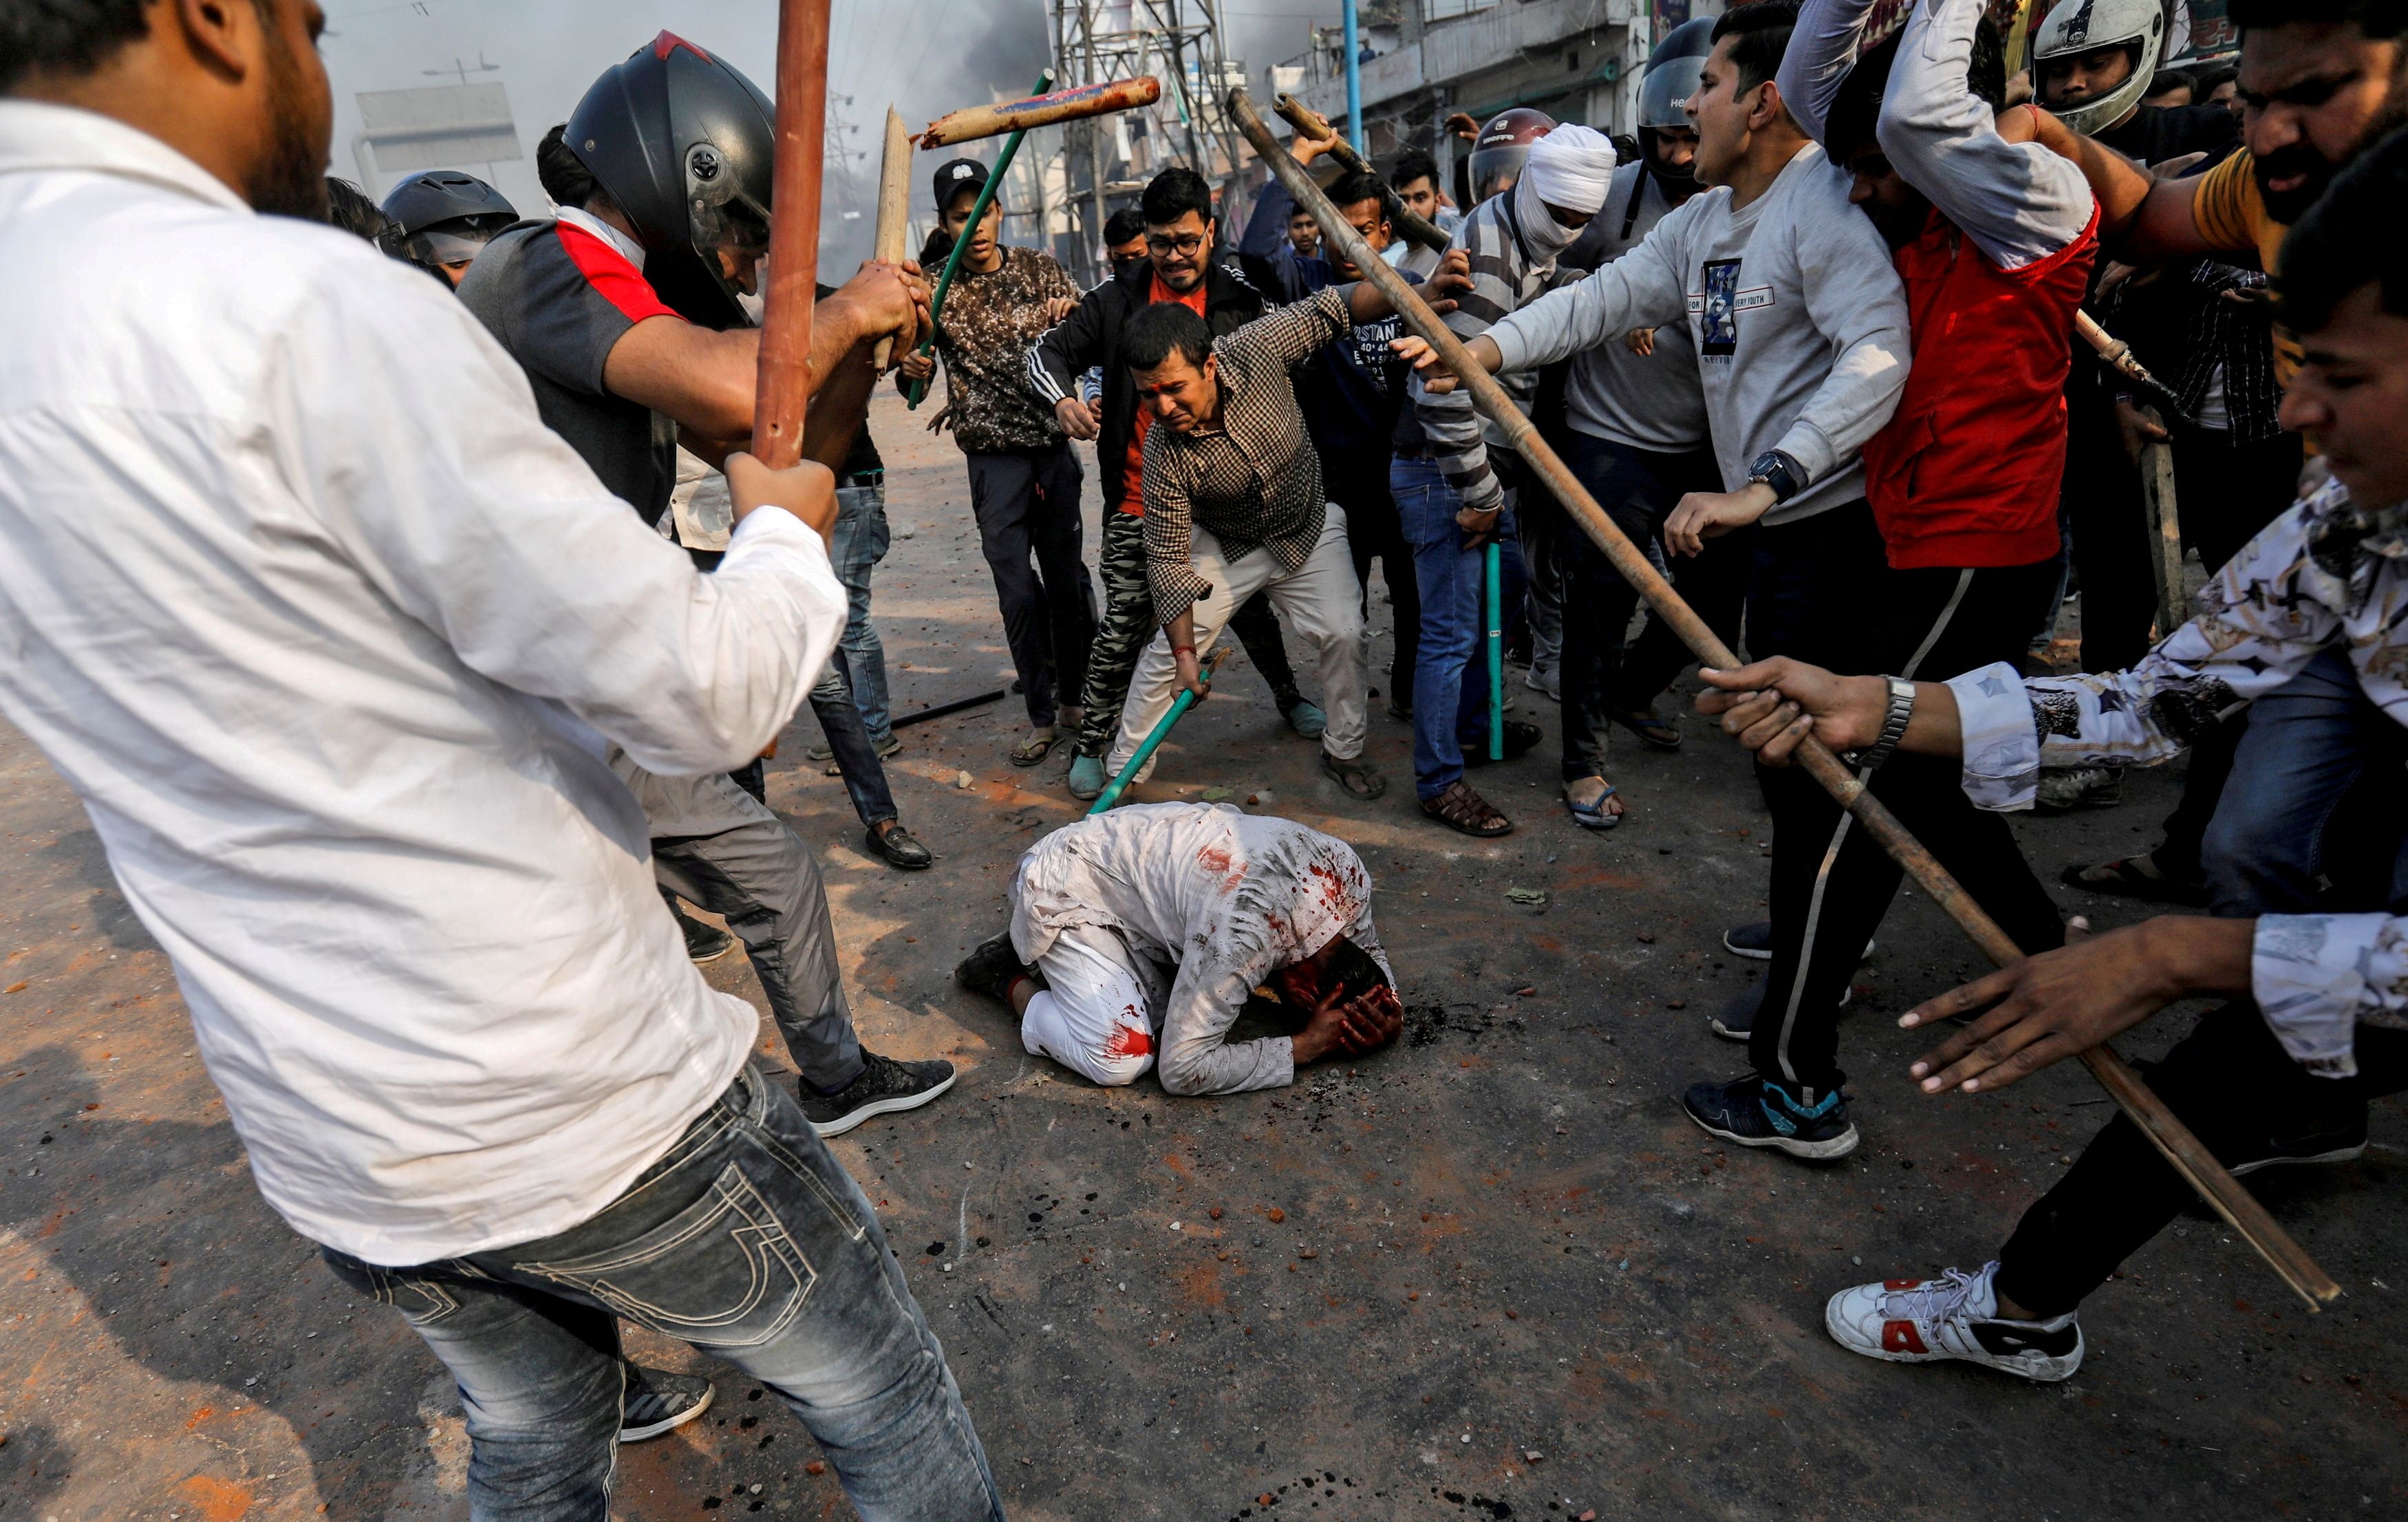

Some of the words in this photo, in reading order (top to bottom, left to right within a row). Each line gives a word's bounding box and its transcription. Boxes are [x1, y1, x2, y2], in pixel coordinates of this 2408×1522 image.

[1670, 98, 1686, 107] He
[1688, 301, 1700, 309] FOR
[1734, 299, 1746, 308] VERY
[1748, 294, 1765, 305] YOUTH
